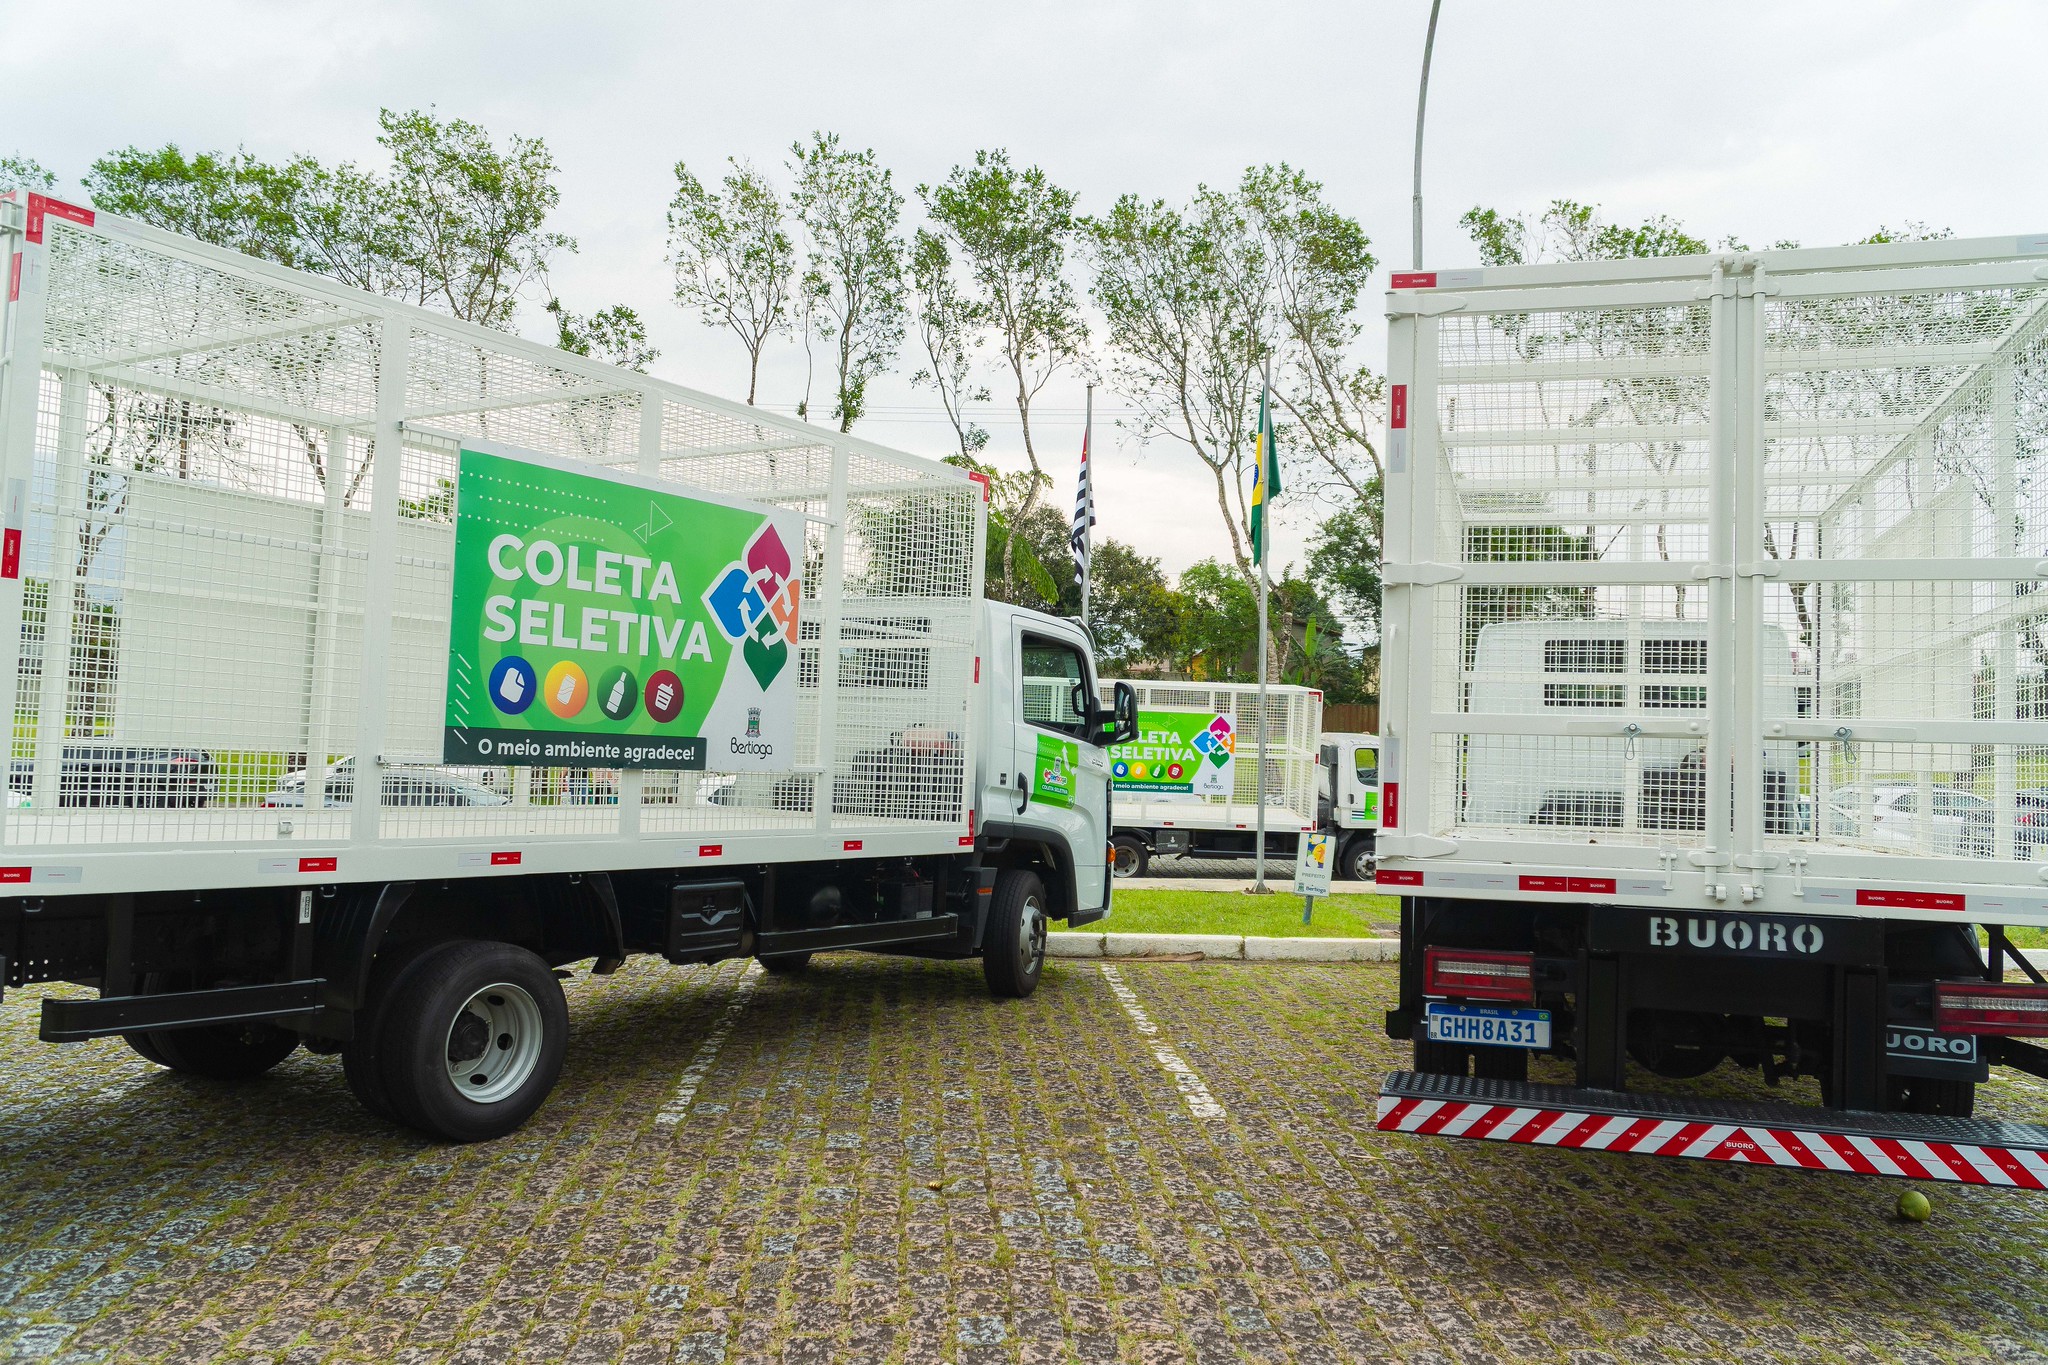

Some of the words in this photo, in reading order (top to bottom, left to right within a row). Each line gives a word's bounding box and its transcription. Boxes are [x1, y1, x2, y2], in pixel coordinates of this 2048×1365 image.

[488, 533, 682, 604] COLETA
[483, 595, 712, 663] SELETIVA
[731, 736, 773, 759] Bertioga
[1131, 730, 1182, 744] LETA
[478, 738, 493, 755] O
[498, 739, 541, 757] meio
[545, 741, 620, 759] ambiente
[624, 745, 695, 762] agradece!
[1110, 745, 1196, 761] SELETIVA
[1302, 872, 1326, 880] PREFEITO
[1650, 917, 1824, 954] BUORO
[1430, 1031, 1438, 1039] BR
[1440, 1016, 1537, 1044] GHH8A31
[1886, 1033, 1972, 1055] UORO
[1726, 1141, 1754, 1150] BUORO
